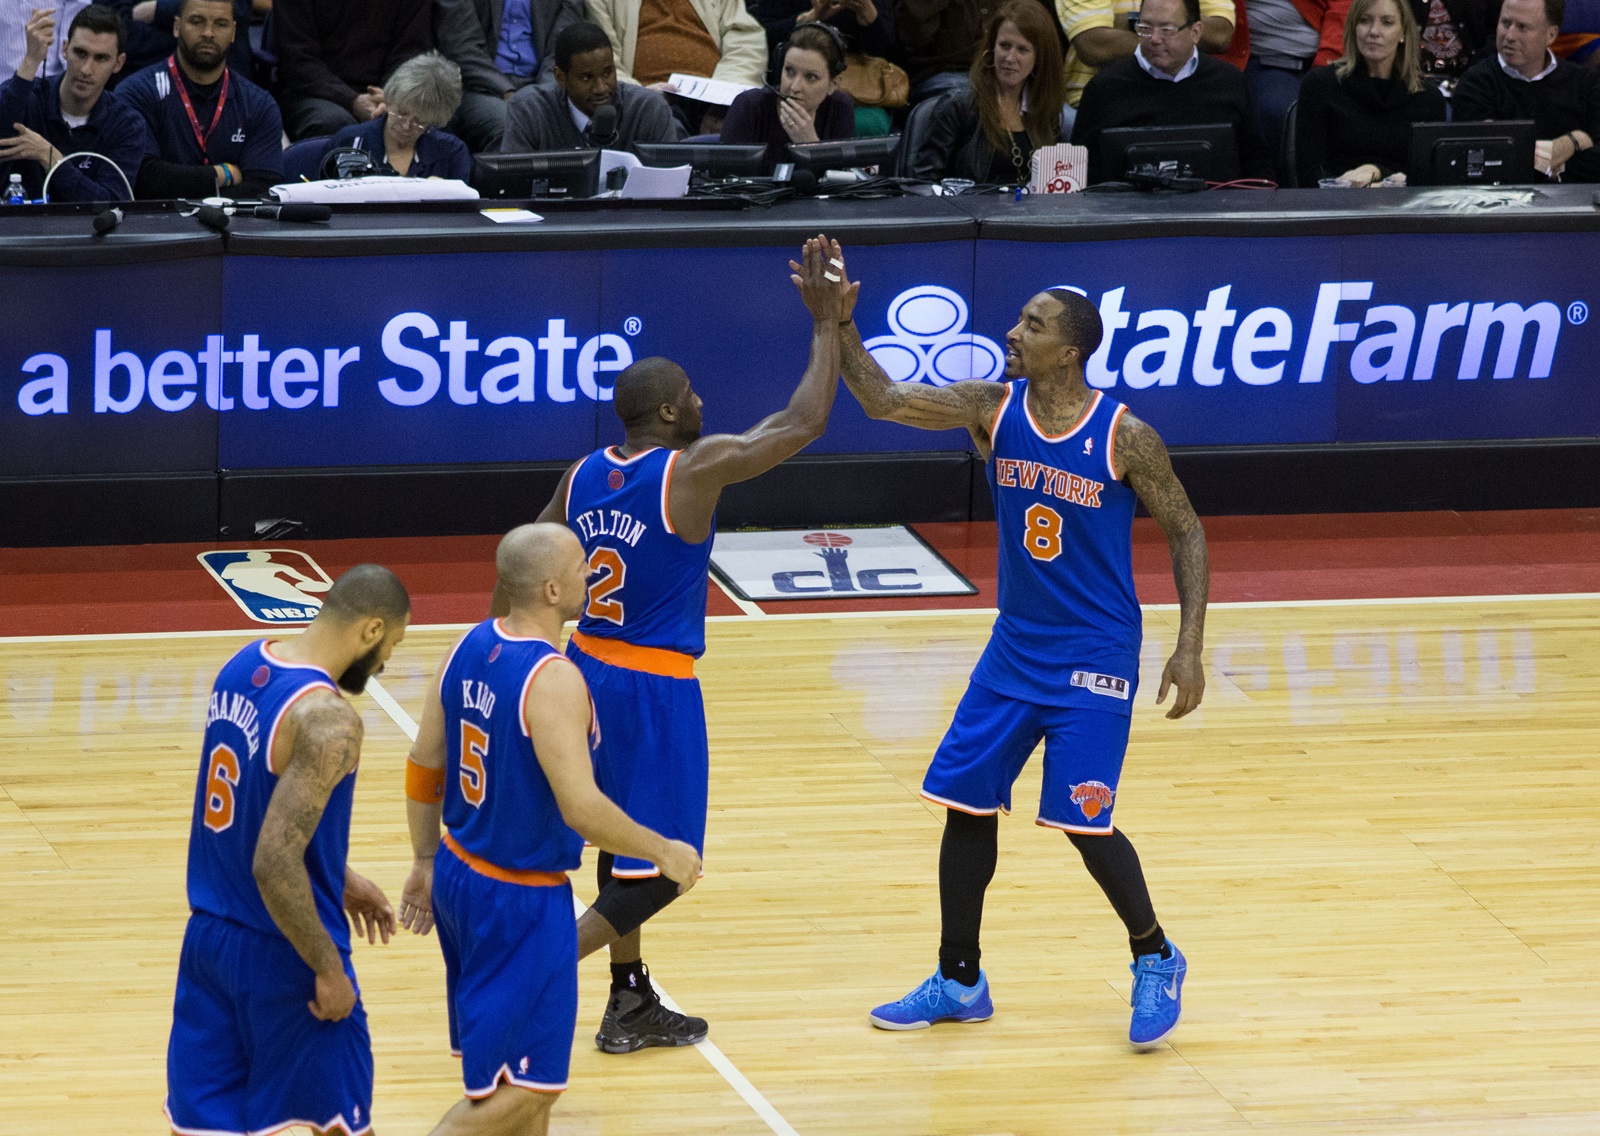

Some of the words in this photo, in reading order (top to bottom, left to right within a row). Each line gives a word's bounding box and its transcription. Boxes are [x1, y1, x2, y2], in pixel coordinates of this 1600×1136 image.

[1048, 178, 1071, 194] POP
[1043, 285, 1293, 390] tate
[17, 353, 69, 416] a
[93, 328, 361, 414] better
[576, 509, 647, 547] FELTON
[1023, 502, 1064, 562] 8
[260, 607, 320, 619] NBA
[585, 546, 627, 627] 2
[462, 680, 496, 719] KIDD
[203, 742, 241, 833] 6
[459, 718, 490, 810] 5
[1070, 784, 1112, 805] KNICKS
